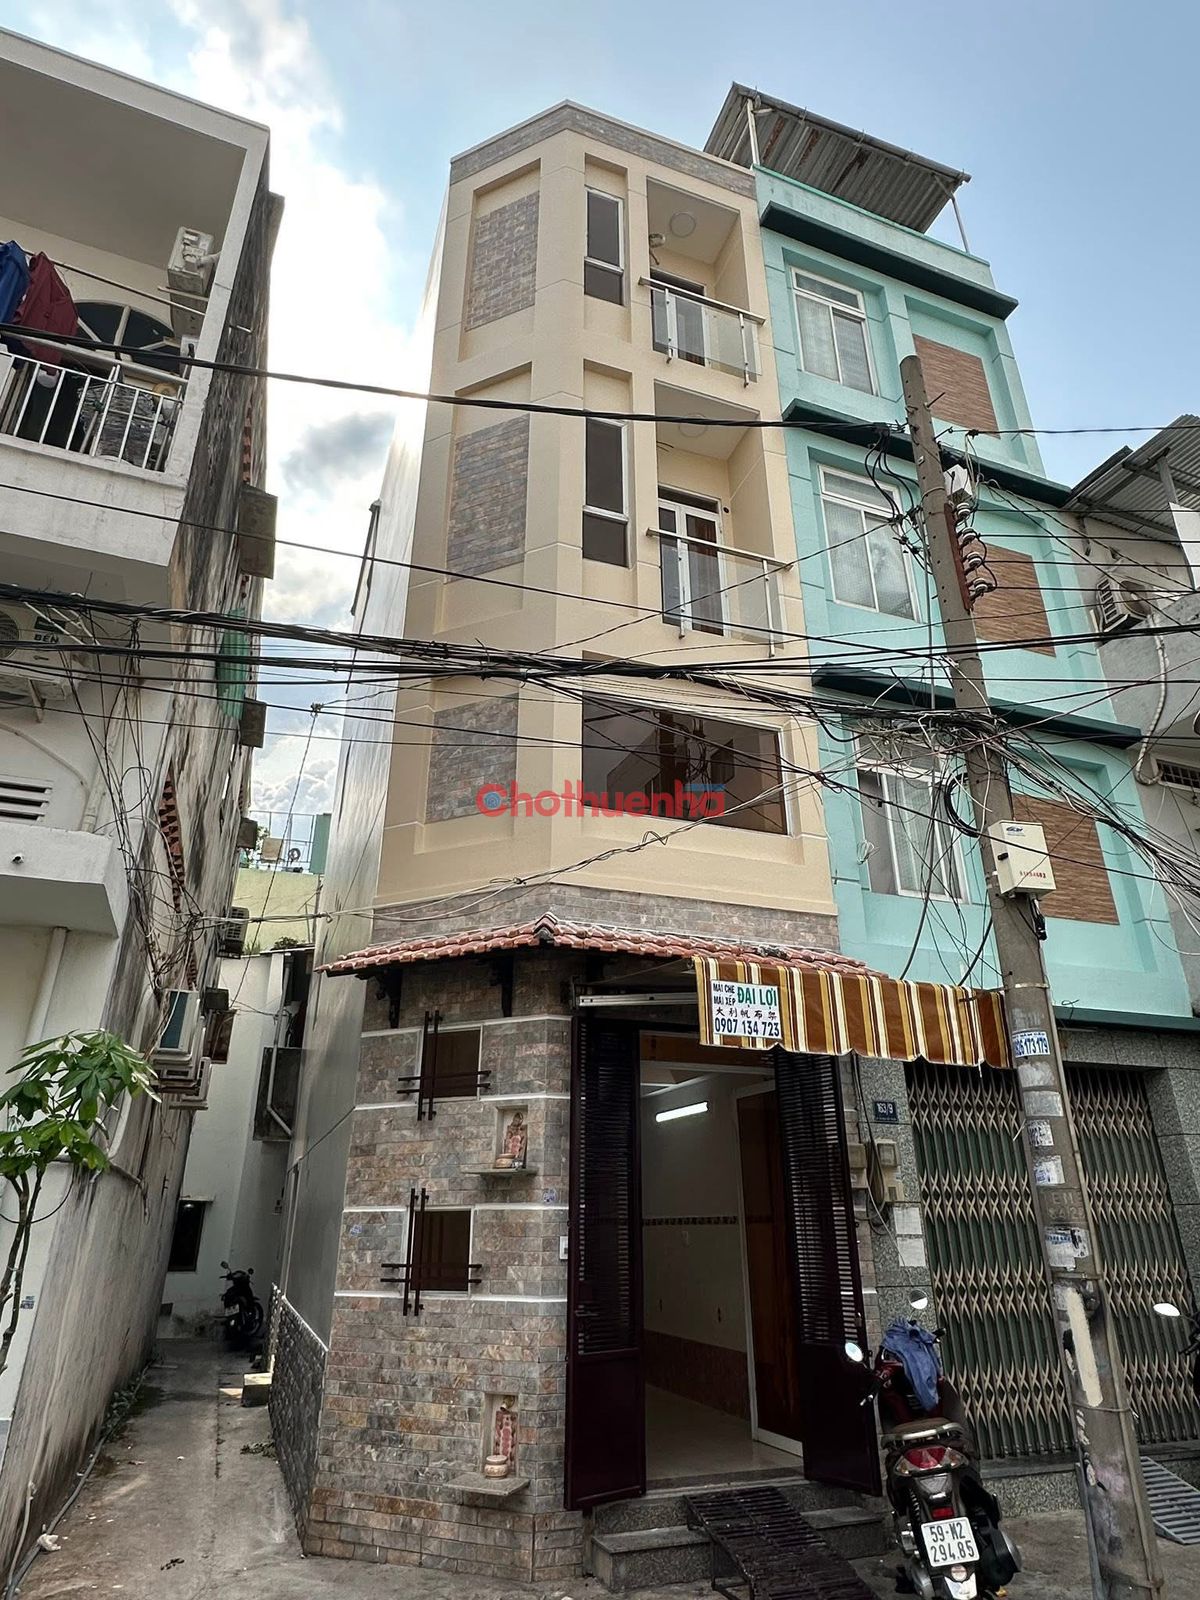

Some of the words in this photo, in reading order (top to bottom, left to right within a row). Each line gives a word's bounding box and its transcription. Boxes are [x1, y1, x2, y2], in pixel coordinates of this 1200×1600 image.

[725, 984, 735, 994] CHE
[737, 986, 756, 1008] ĐẠI
[760, 987, 777, 1010] LỢI
[714, 1017, 738, 1034] 0907
[742, 1020, 759, 1036] 134
[761, 1021, 780, 1037] 723
[930, 1540, 975, 1563] 294.85
